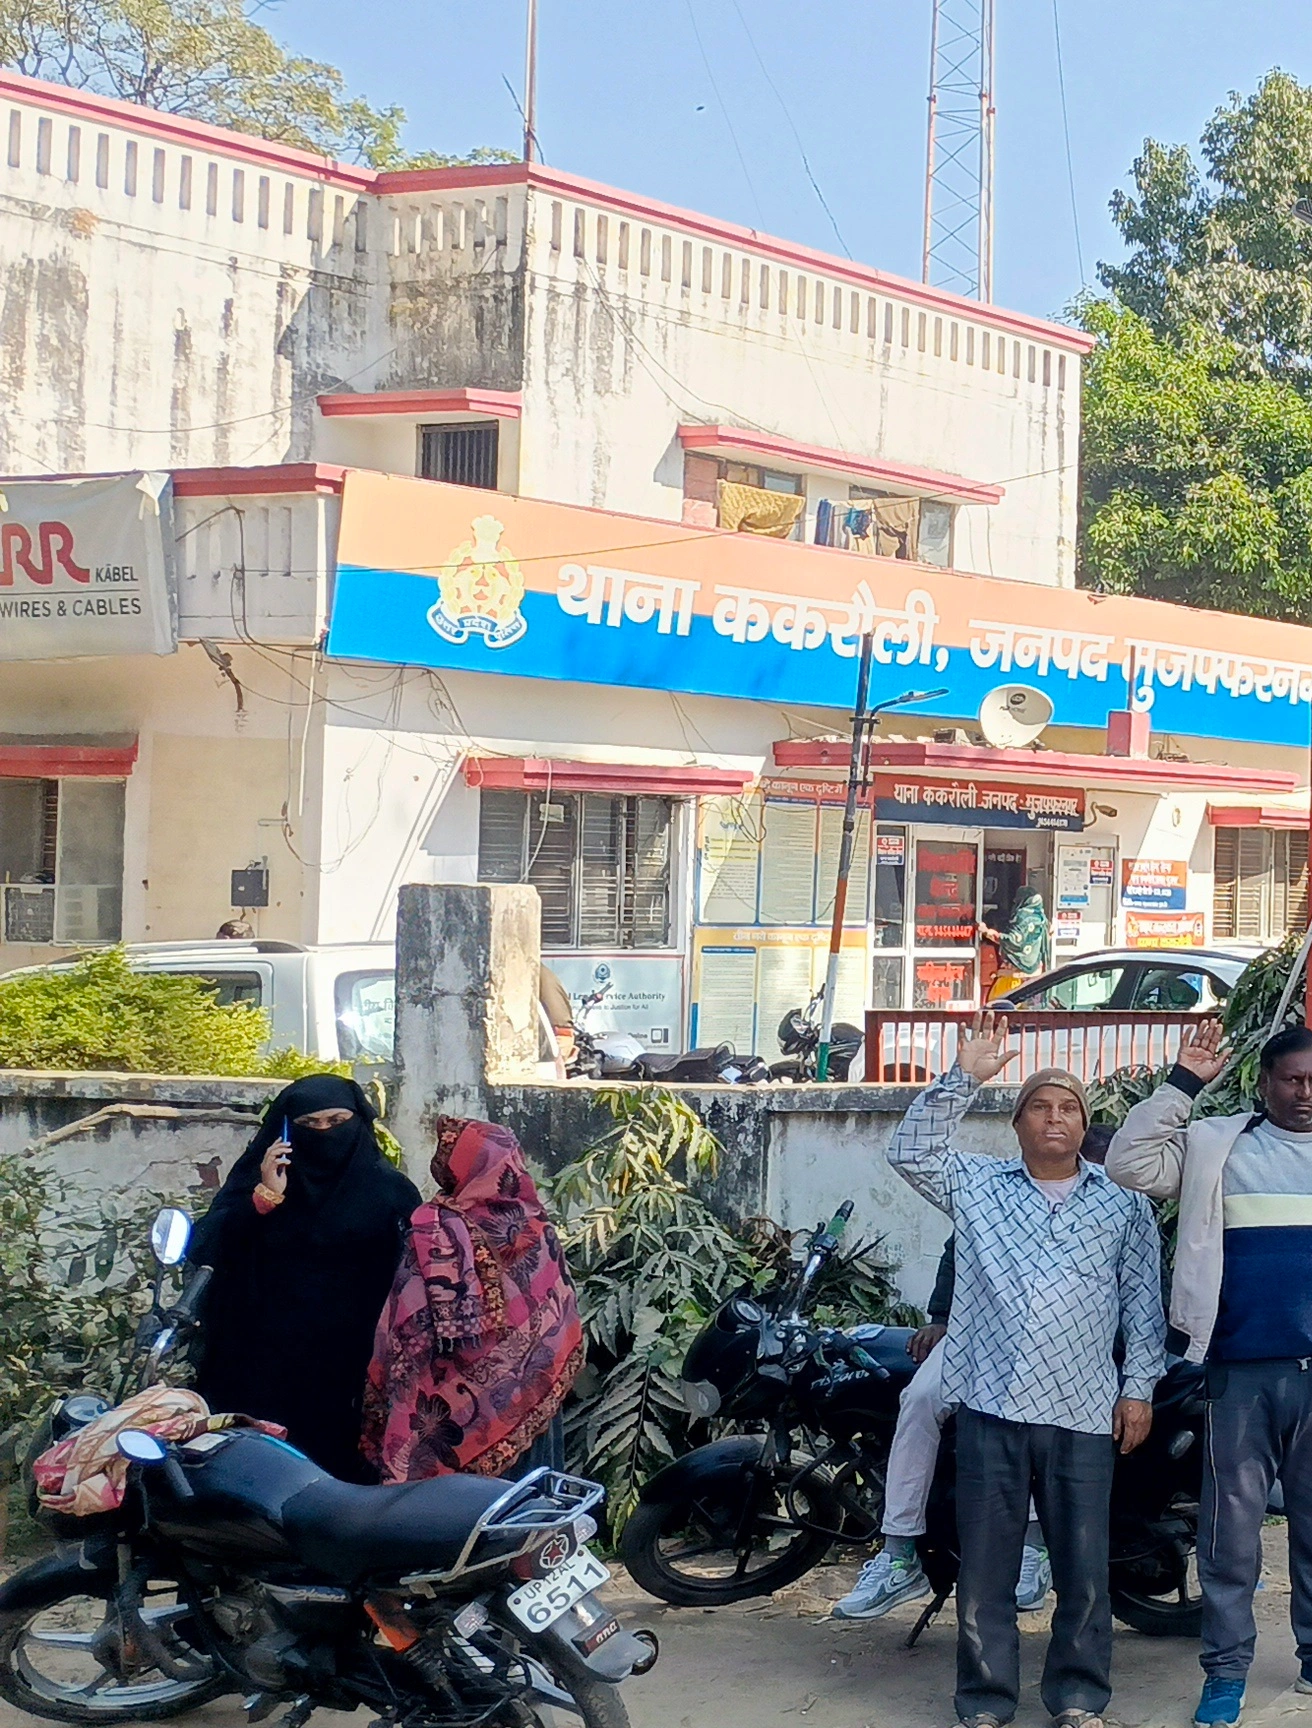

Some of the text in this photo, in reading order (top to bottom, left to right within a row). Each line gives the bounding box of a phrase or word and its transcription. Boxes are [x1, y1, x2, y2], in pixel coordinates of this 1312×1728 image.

[0, 598, 142, 618] WIRES & CABLES
[556, 563, 701, 636] थाना
[967, 619, 1115, 682] जनपद
[893, 783, 919, 805] थाना
[628, 992, 666, 1002] Authority
[527, 1563, 603, 1624] 6511
